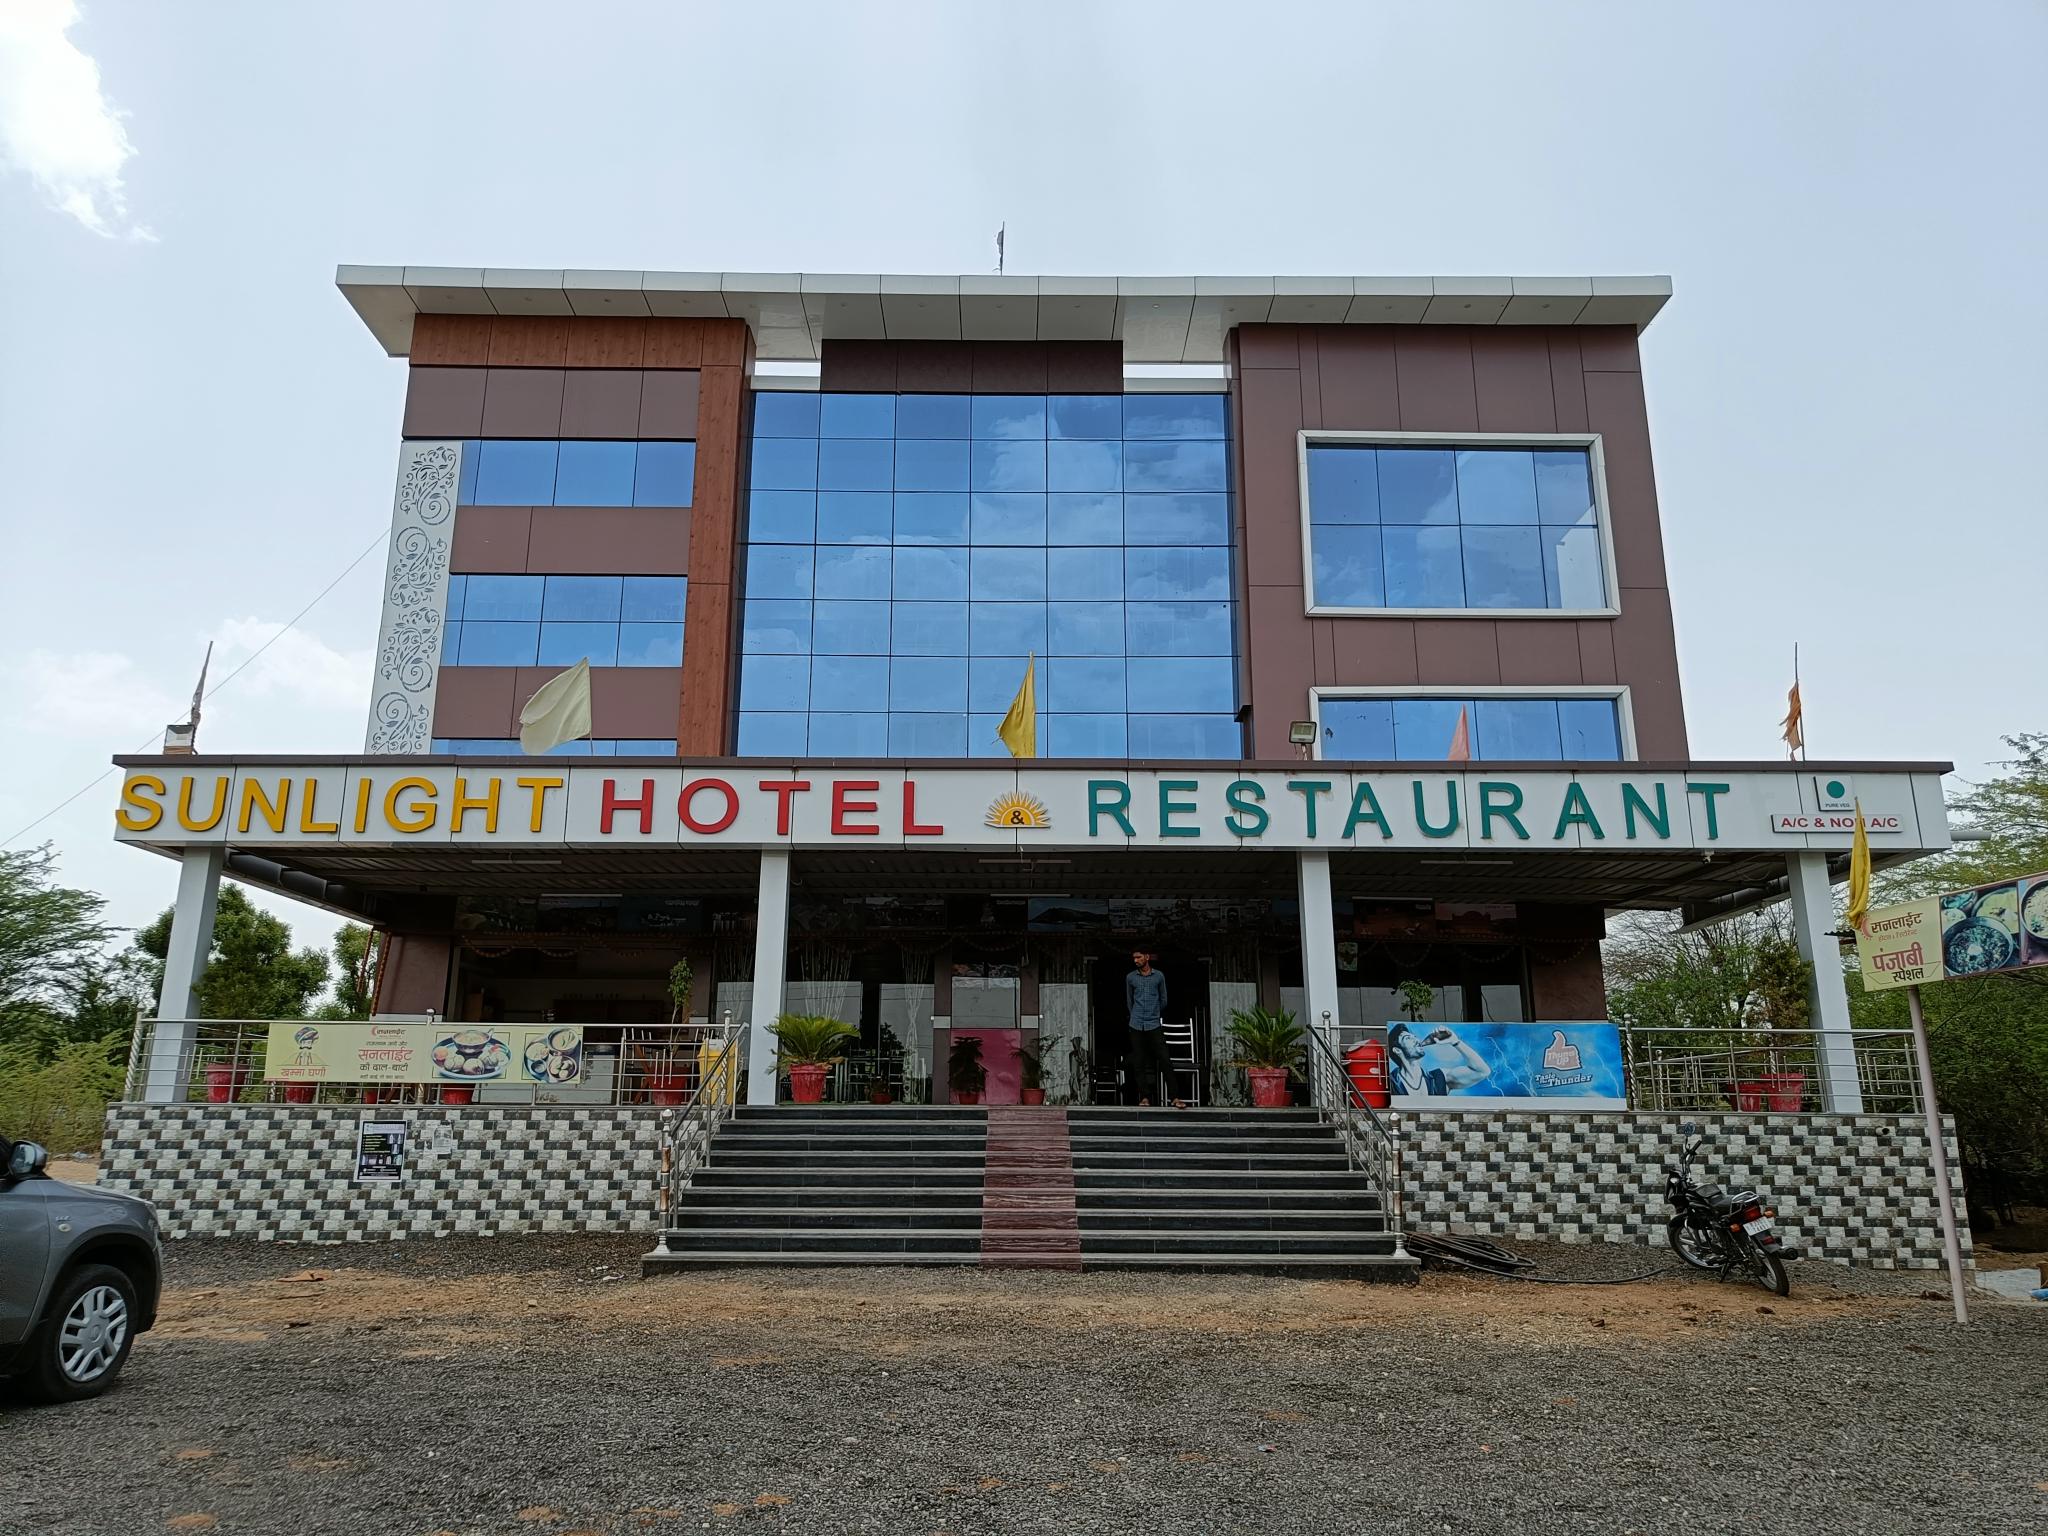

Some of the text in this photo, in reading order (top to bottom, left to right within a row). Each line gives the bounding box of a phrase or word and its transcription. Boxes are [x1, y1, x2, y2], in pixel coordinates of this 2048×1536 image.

[115, 774, 1730, 840] SUNLIGHT HOTEL & RESTAURANT
[1781, 818, 1808, 828] A/C
[1814, 818, 1825, 828] &
[1871, 818, 1898, 828] A/C
[1870, 912, 1923, 934] सनलाईट
[1872, 941, 1924, 972] पंजाबी
[1892, 967, 1924, 982] स्पेशल
[358, 1047, 413, 1062] सनलाईट
[1547, 1074, 1592, 1086] Thunder
